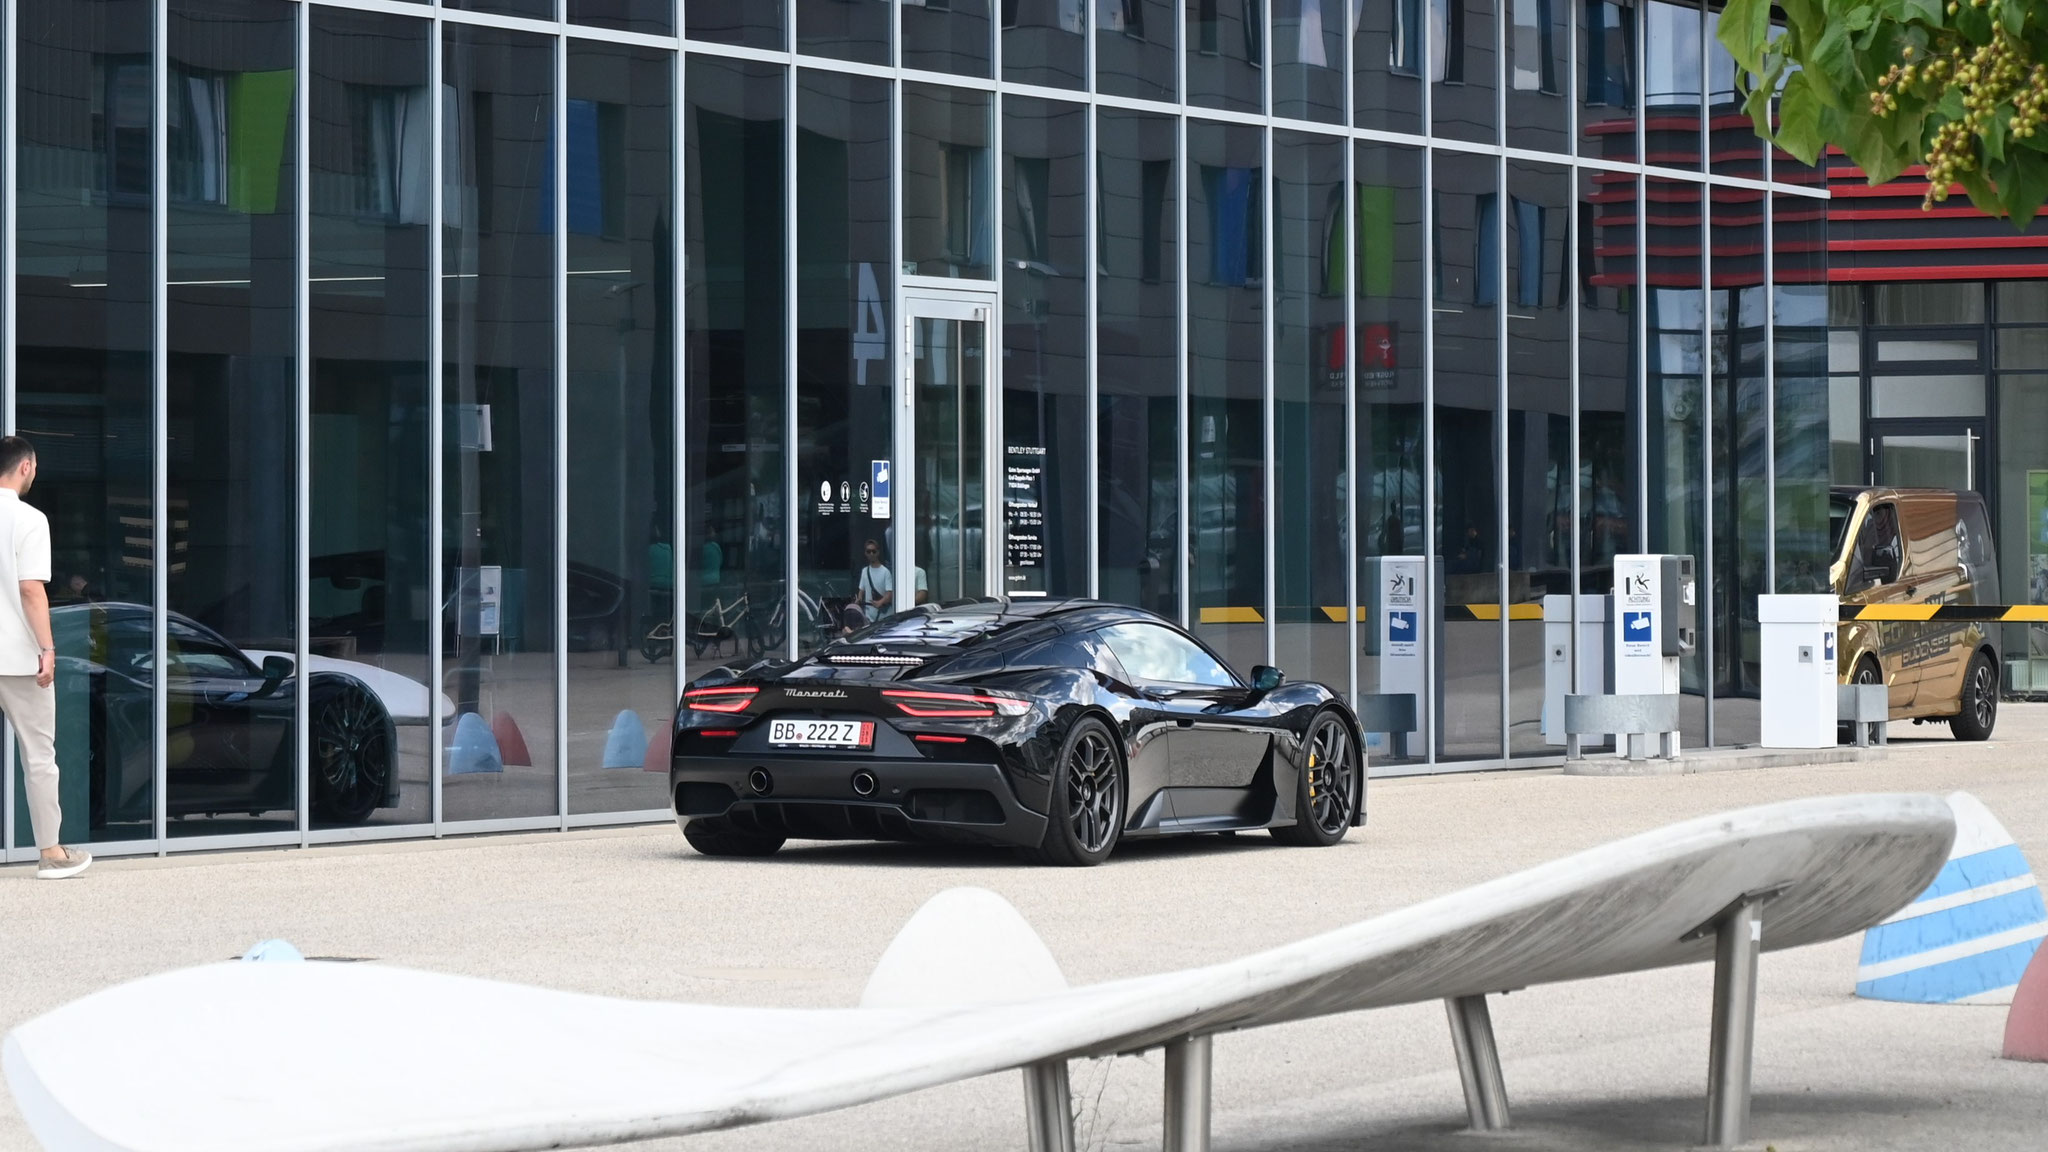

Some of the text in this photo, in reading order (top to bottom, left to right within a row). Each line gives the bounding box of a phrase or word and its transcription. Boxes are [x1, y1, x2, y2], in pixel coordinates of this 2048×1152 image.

[1008, 446, 1024, 454] BENTLEY
[784, 688, 848, 698] Maserati
[774, 723, 796, 740] BB
[807, 723, 839, 741] 222
[842, 724, 854, 742] Z
